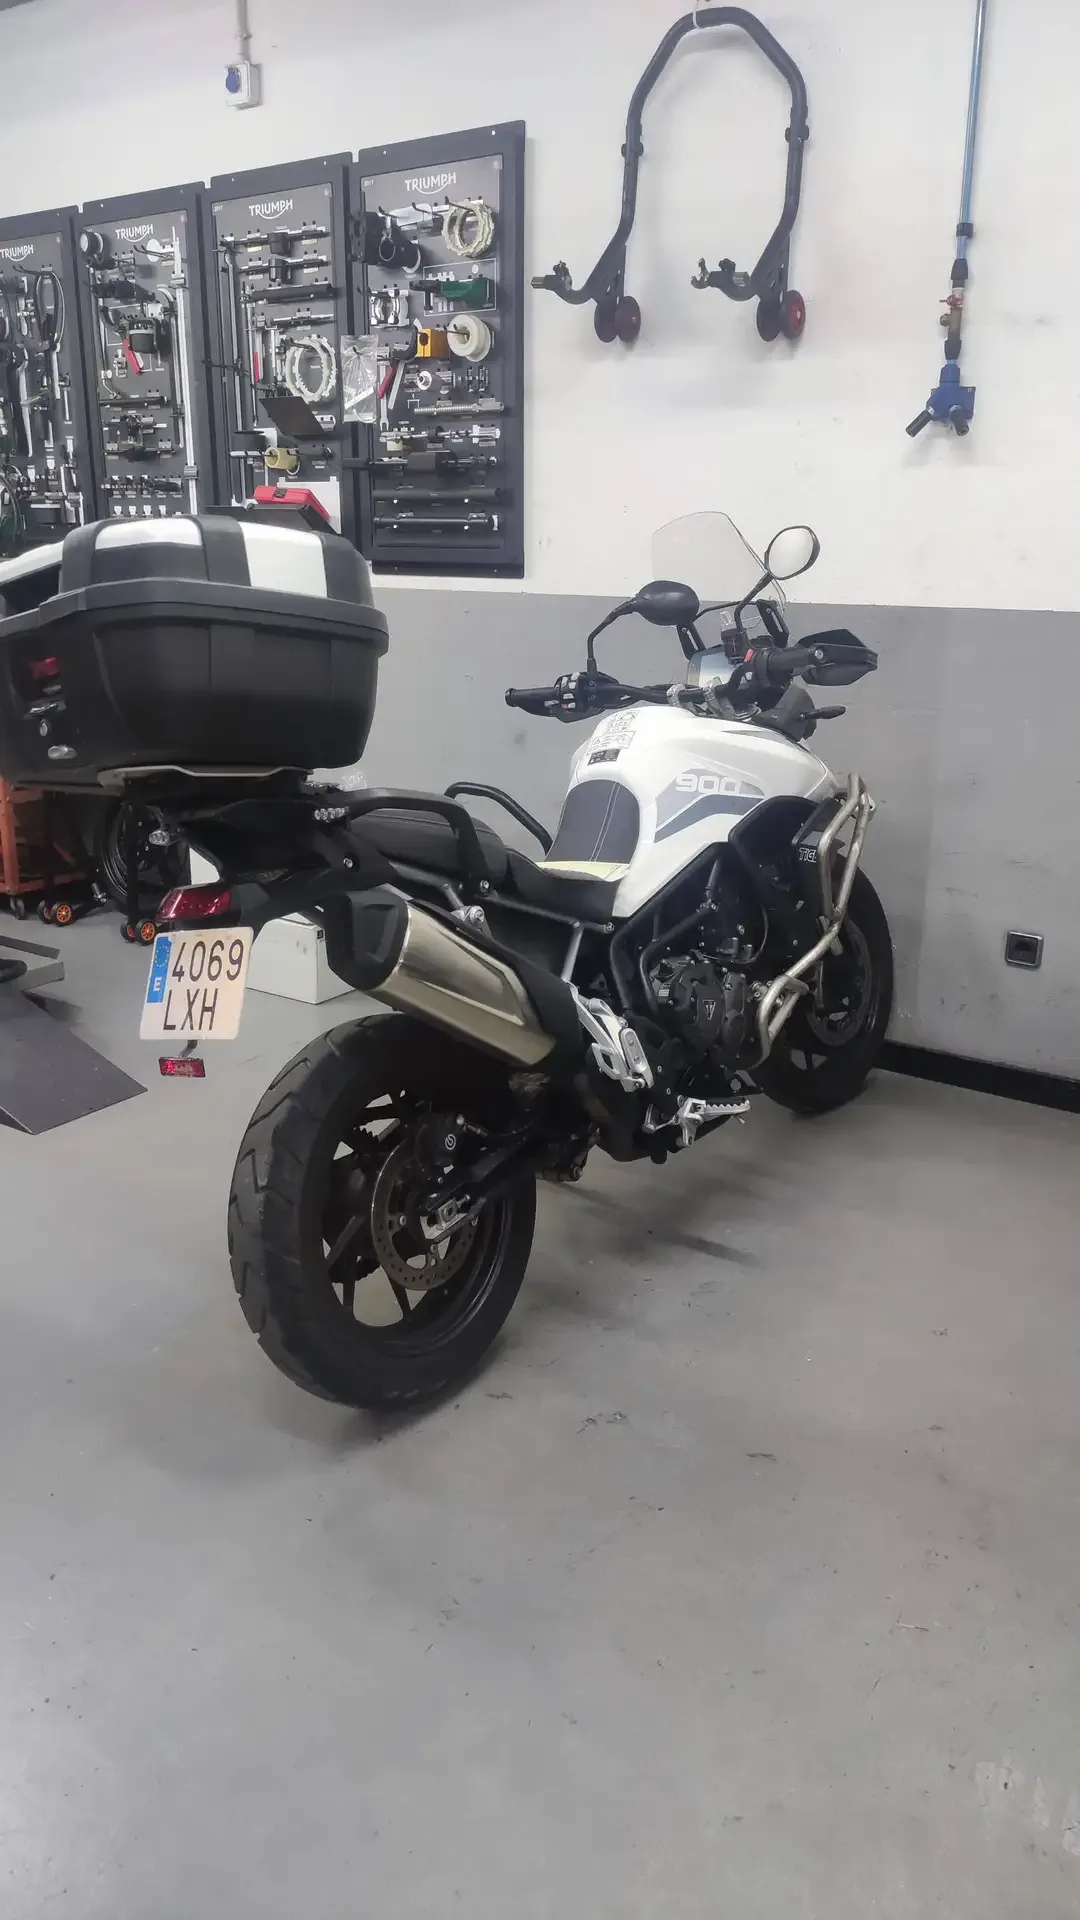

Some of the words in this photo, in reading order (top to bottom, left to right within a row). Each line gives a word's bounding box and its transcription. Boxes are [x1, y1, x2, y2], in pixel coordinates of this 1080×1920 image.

[405, 172, 456, 194] TRIUMPH
[249, 199, 293, 219] TRIUMPH
[115, 224, 154, 242] TRIUMPH
[0, 244, 34, 261] TRIUMPH
[676, 773, 741, 795] 900
[172, 939, 244, 982] 4069
[153, 977, 162, 991] E
[163, 988, 218, 1031] LXH
